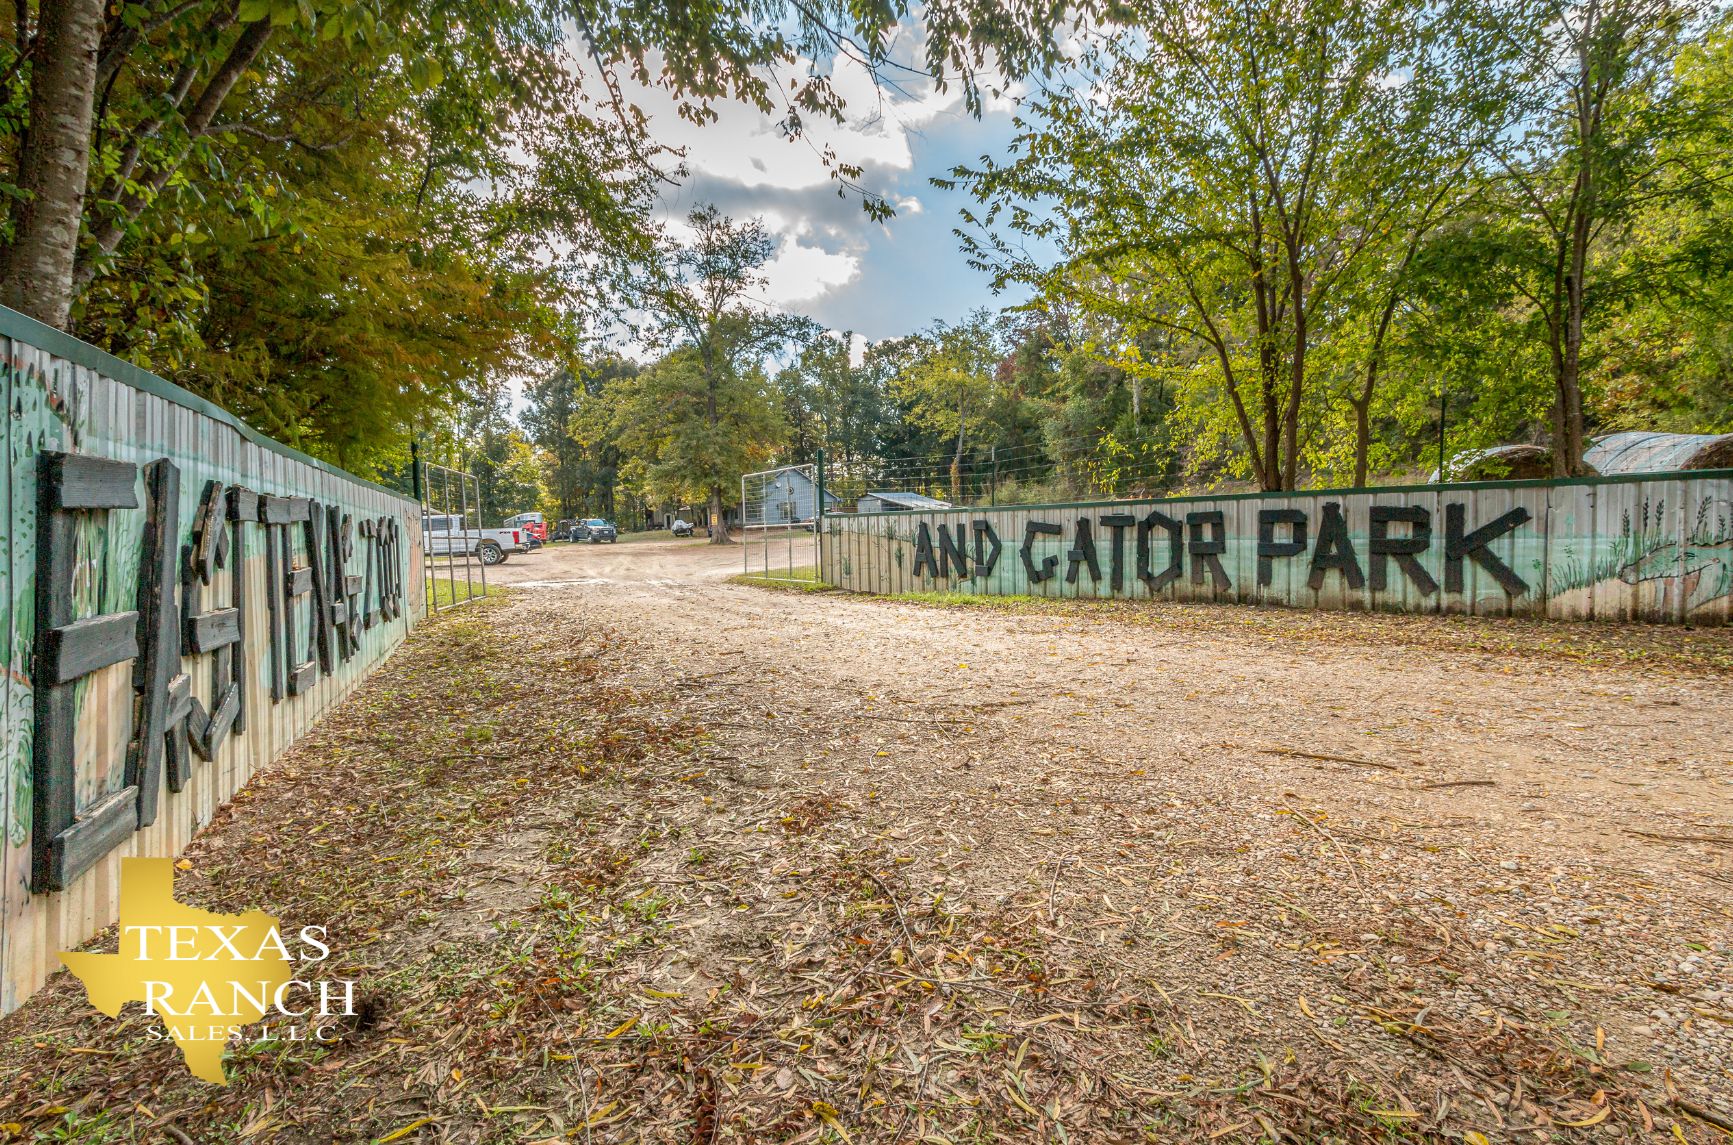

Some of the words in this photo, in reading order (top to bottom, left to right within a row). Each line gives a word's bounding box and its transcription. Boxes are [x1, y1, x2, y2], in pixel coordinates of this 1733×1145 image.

[912, 520, 1002, 578] AND
[1019, 511, 1232, 592] GATOR
[1257, 501, 1532, 597] PARK
